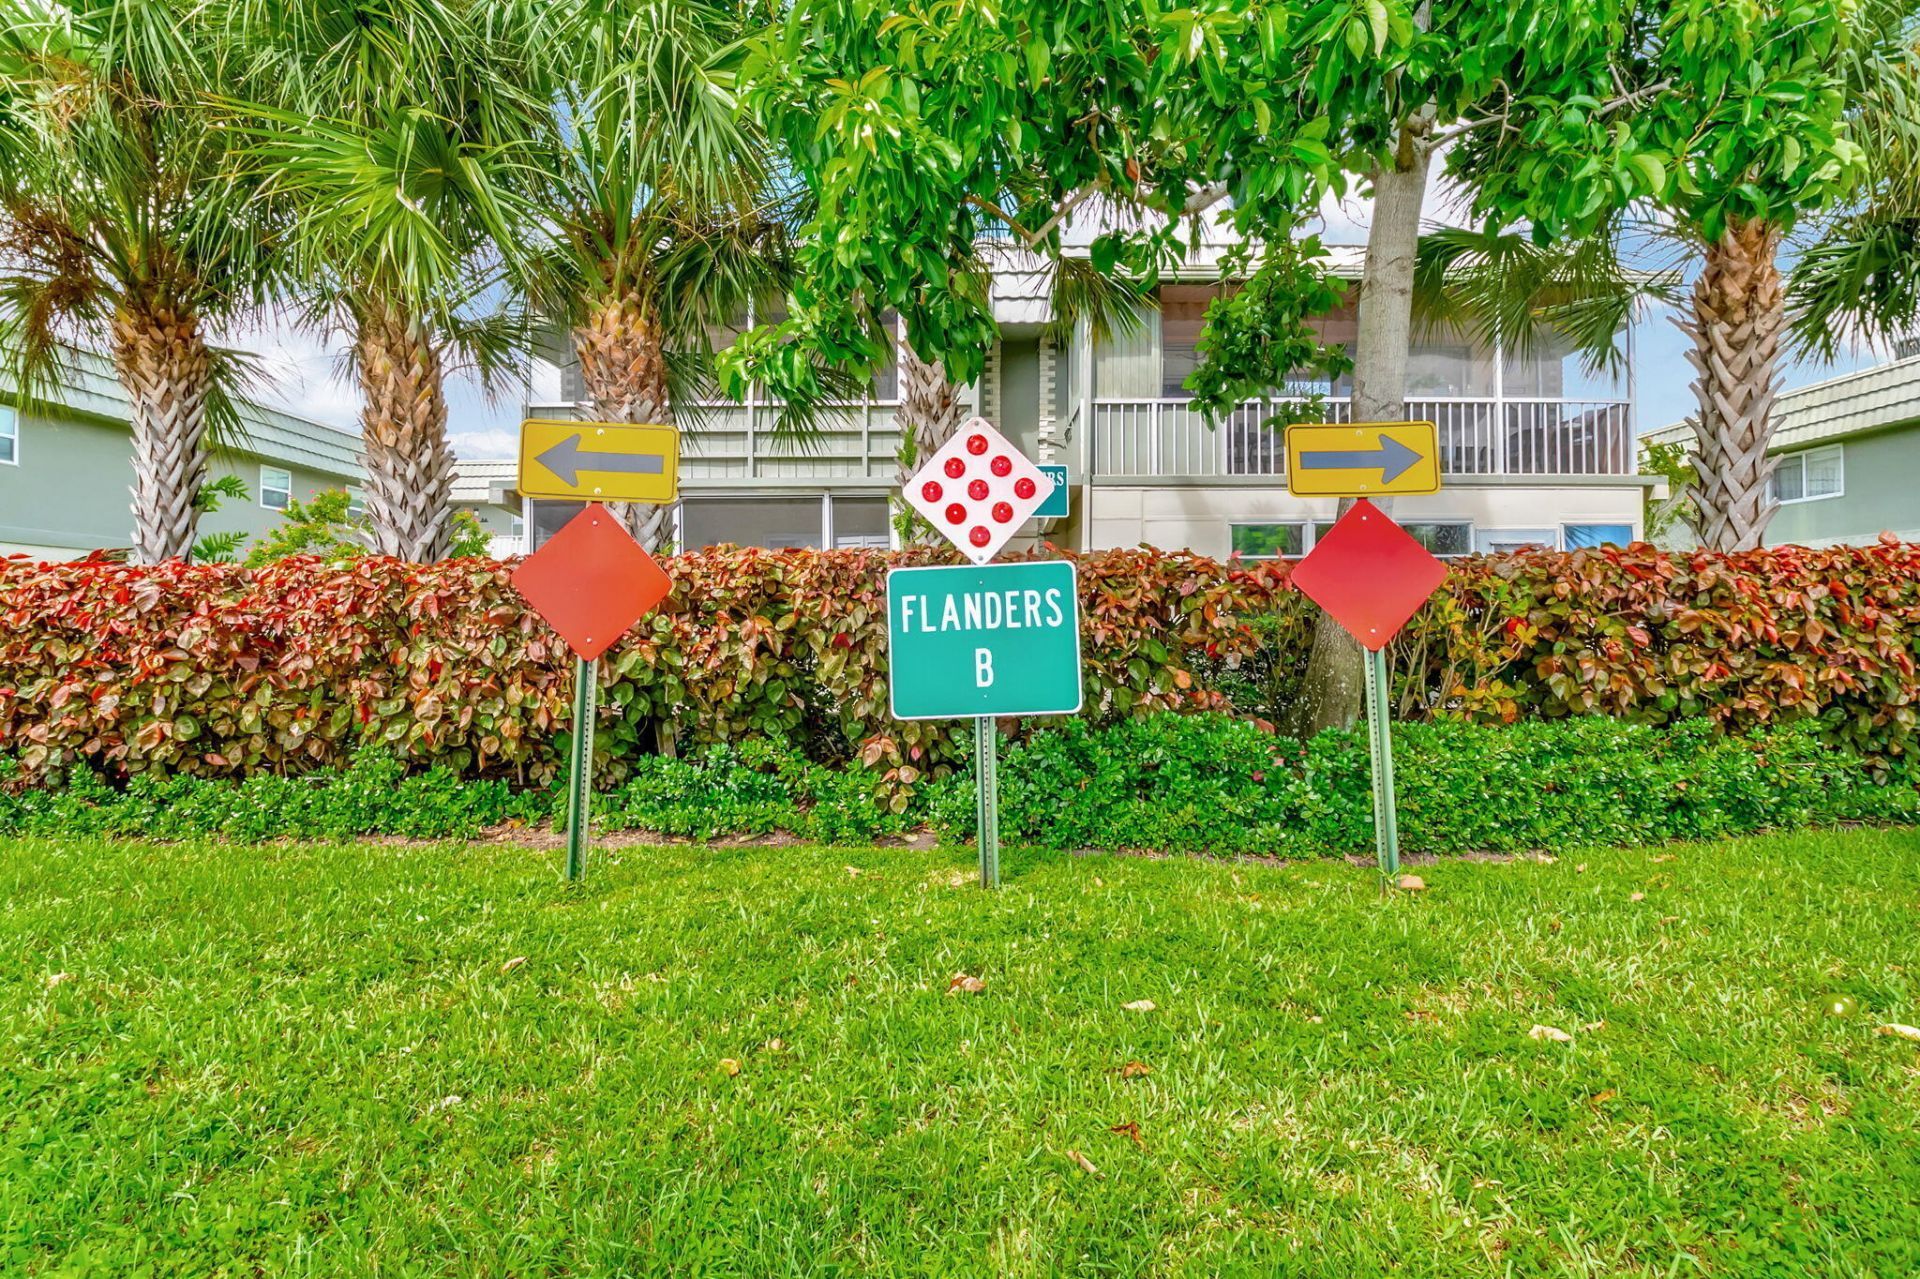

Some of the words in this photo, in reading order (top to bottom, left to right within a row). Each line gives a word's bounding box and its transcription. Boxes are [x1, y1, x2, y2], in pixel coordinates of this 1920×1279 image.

[1044, 471, 1065, 487] RS
[901, 588, 1063, 633] FLANDERS
[975, 648, 994, 688] B
